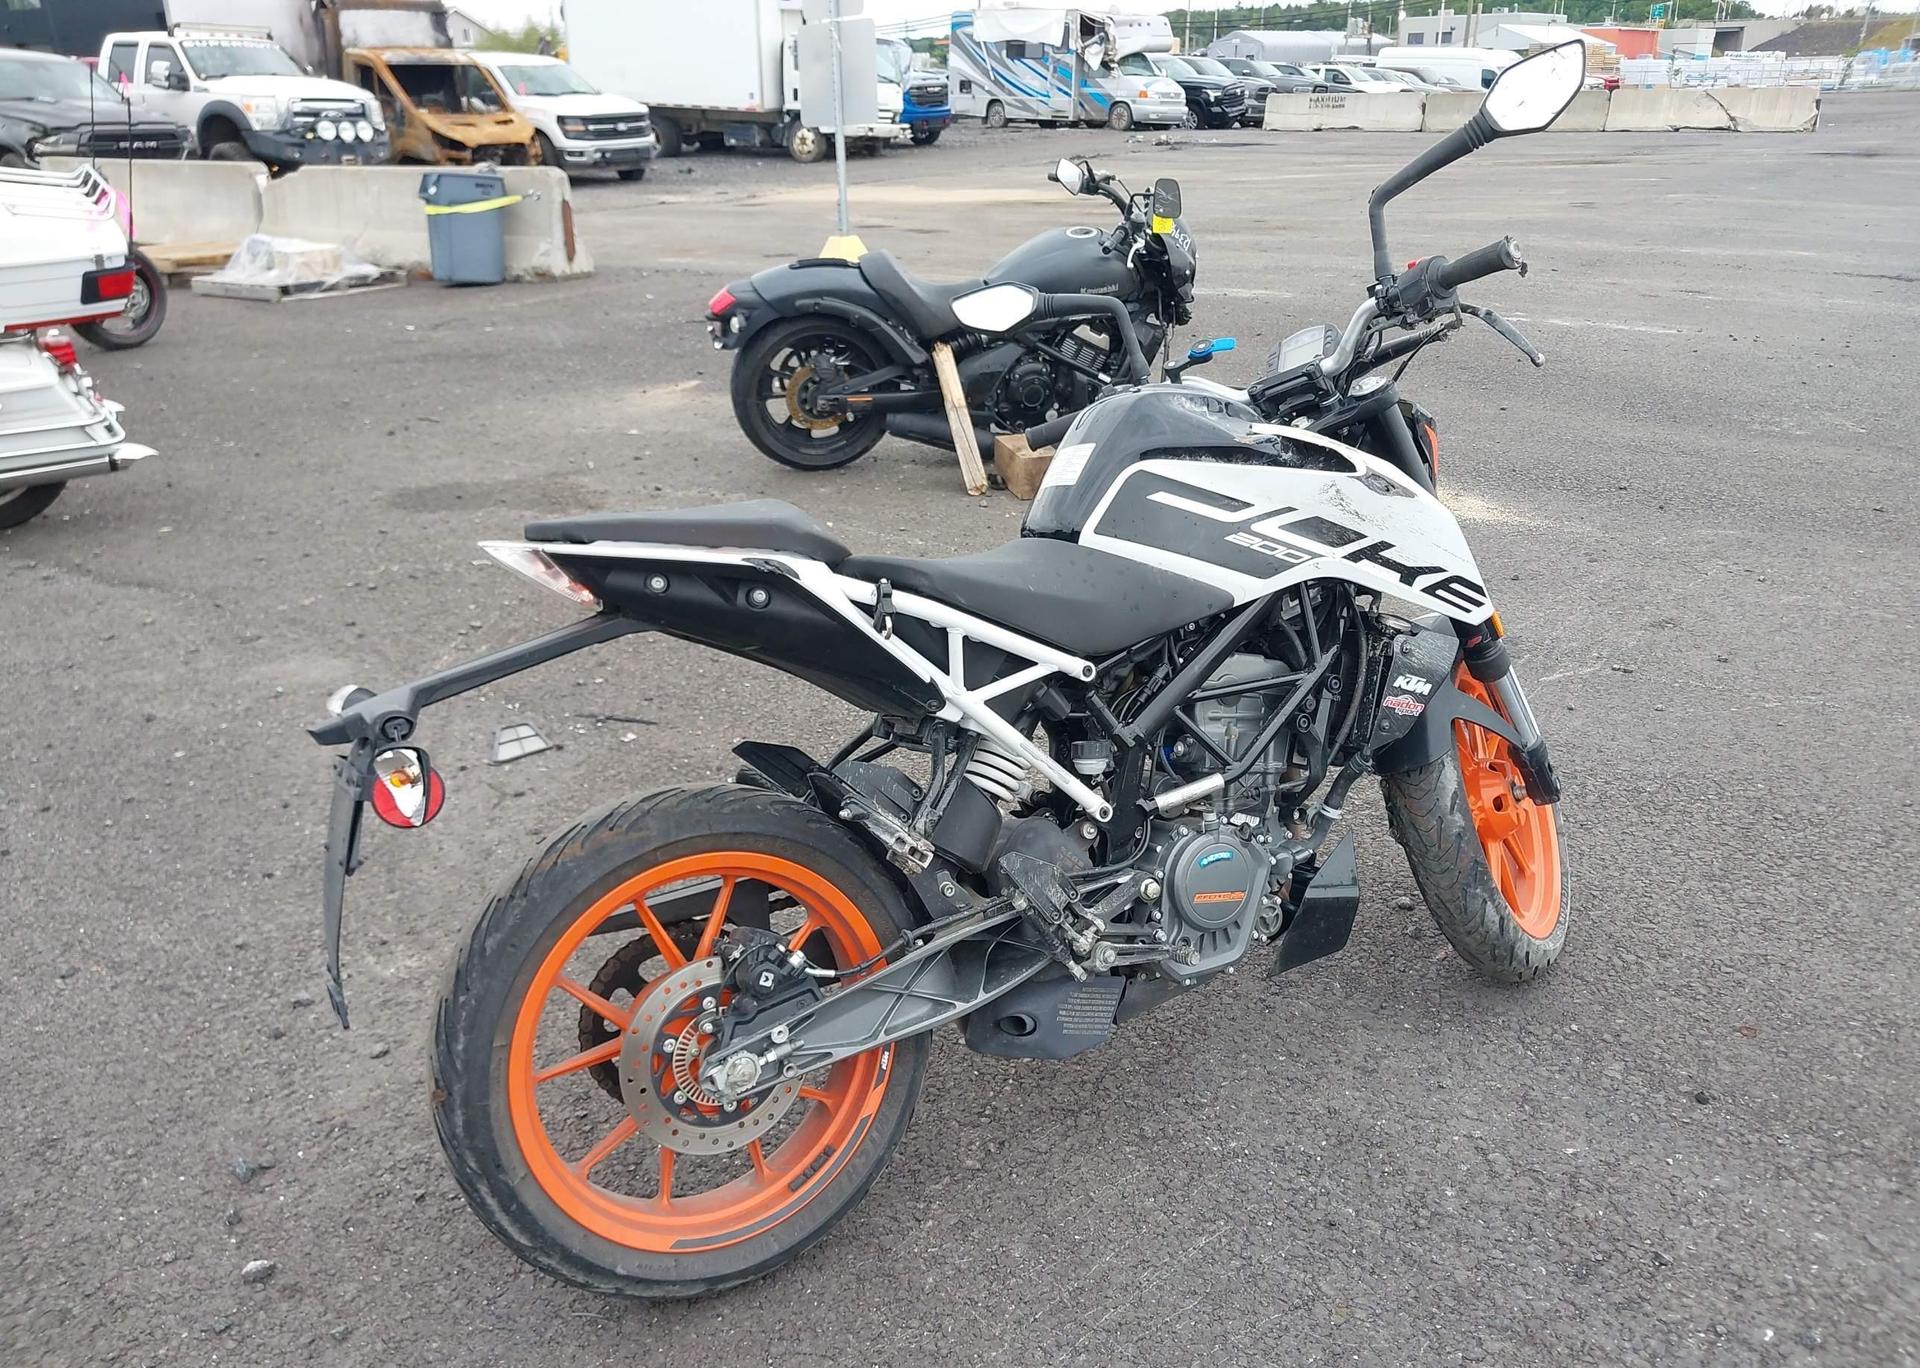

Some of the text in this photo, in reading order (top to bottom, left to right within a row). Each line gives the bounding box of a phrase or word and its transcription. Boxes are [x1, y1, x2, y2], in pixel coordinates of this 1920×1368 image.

[1146, 484, 1489, 615] DUKE
[1223, 531, 1313, 564] 200
[1392, 674, 1433, 696] KTM
